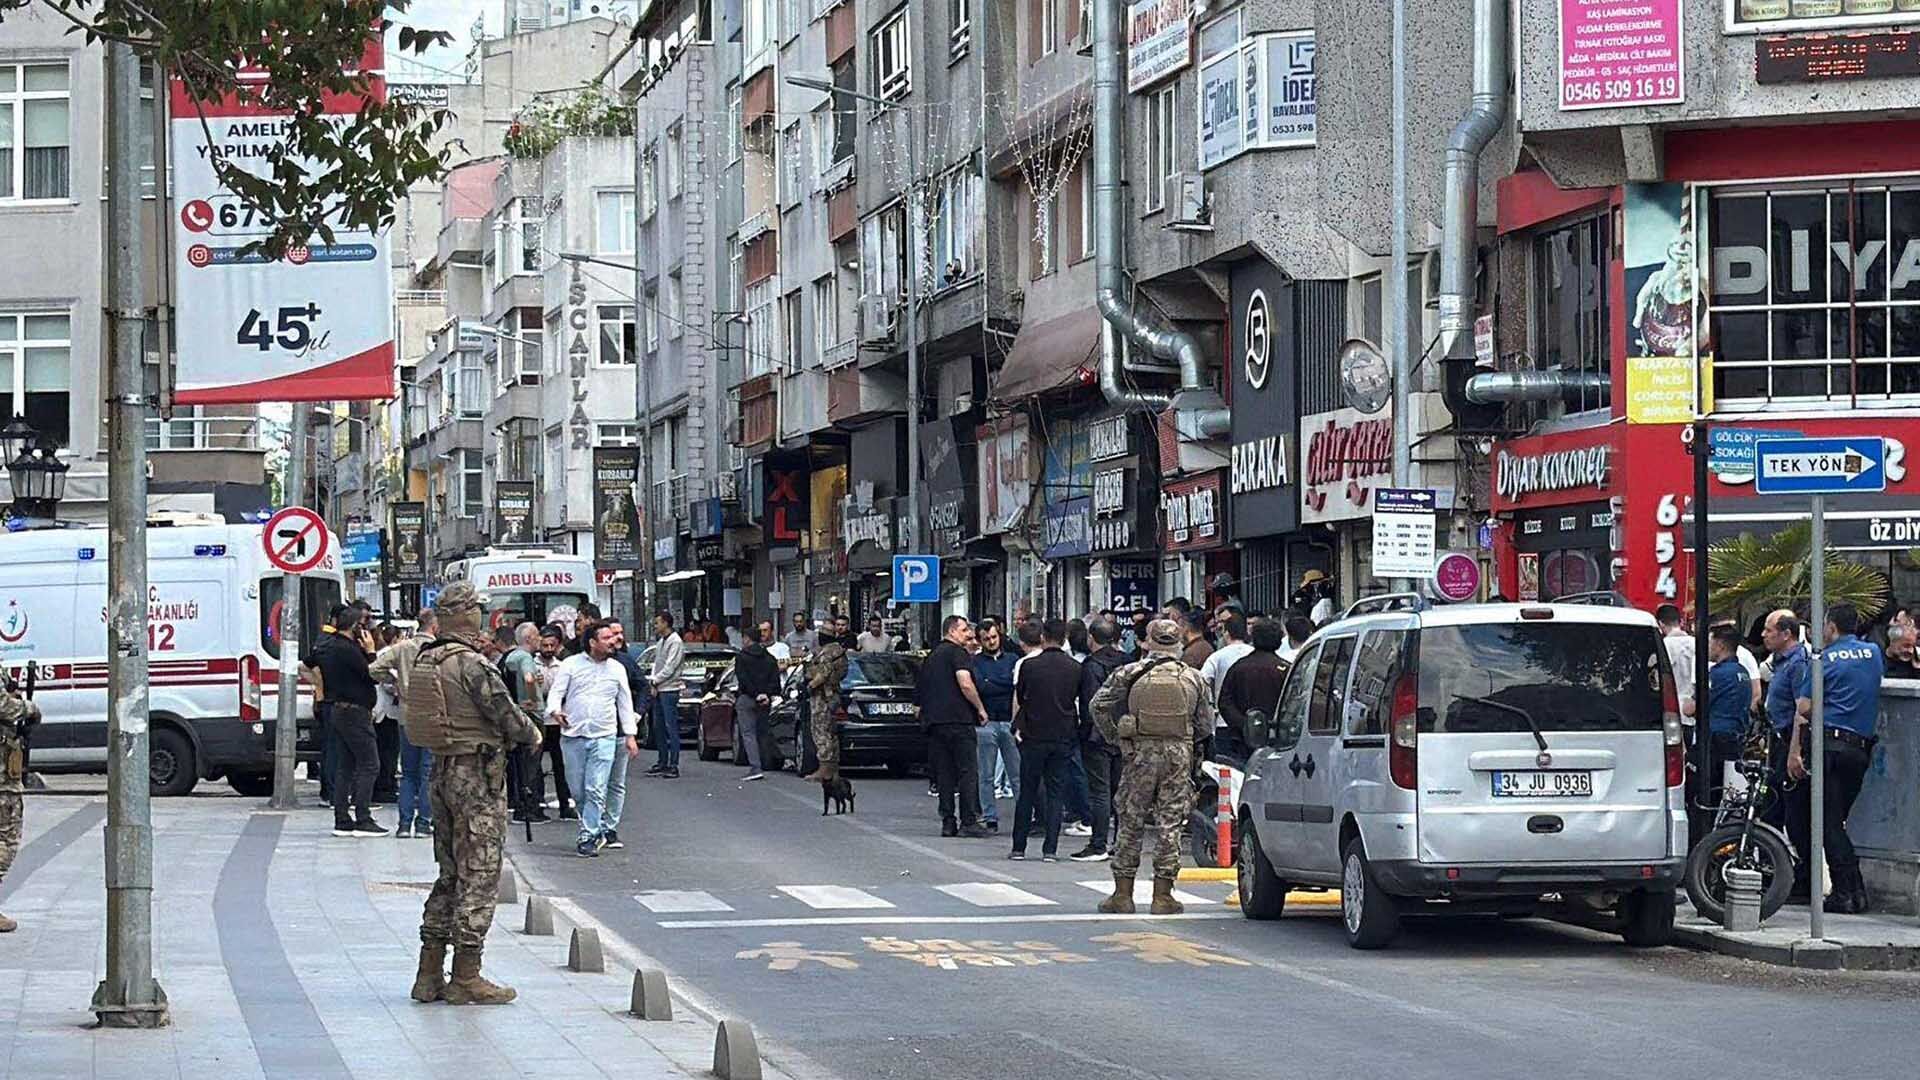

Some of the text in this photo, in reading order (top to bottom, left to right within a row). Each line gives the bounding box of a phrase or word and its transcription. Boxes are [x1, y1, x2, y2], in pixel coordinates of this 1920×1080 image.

[1617, 65, 1632, 77] SAÇ
[1565, 77, 1675, 102] 0546 509 16 19
[1272, 123, 1314, 134] 0533 598
[1715, 445, 1755, 459] SOKAĞI
[1231, 434, 1288, 495] BARAKA
[1770, 455, 1842, 473] TEK YÖN
[1497, 446, 1606, 503] DİYAR KOKOREÇ
[1870, 518, 1891, 541] ÖZ
[487, 571, 574, 588] AMBULANS
[900, 559, 929, 597] P
[1112, 563, 1155, 579] SIFIR
[1129, 582, 1137, 591] &
[148, 601, 199, 621] AKANLIĞI
[1114, 594, 1153, 611] 2.EL
[148, 624, 175, 651] 12
[1503, 774, 1589, 791] 34 JU 0936
